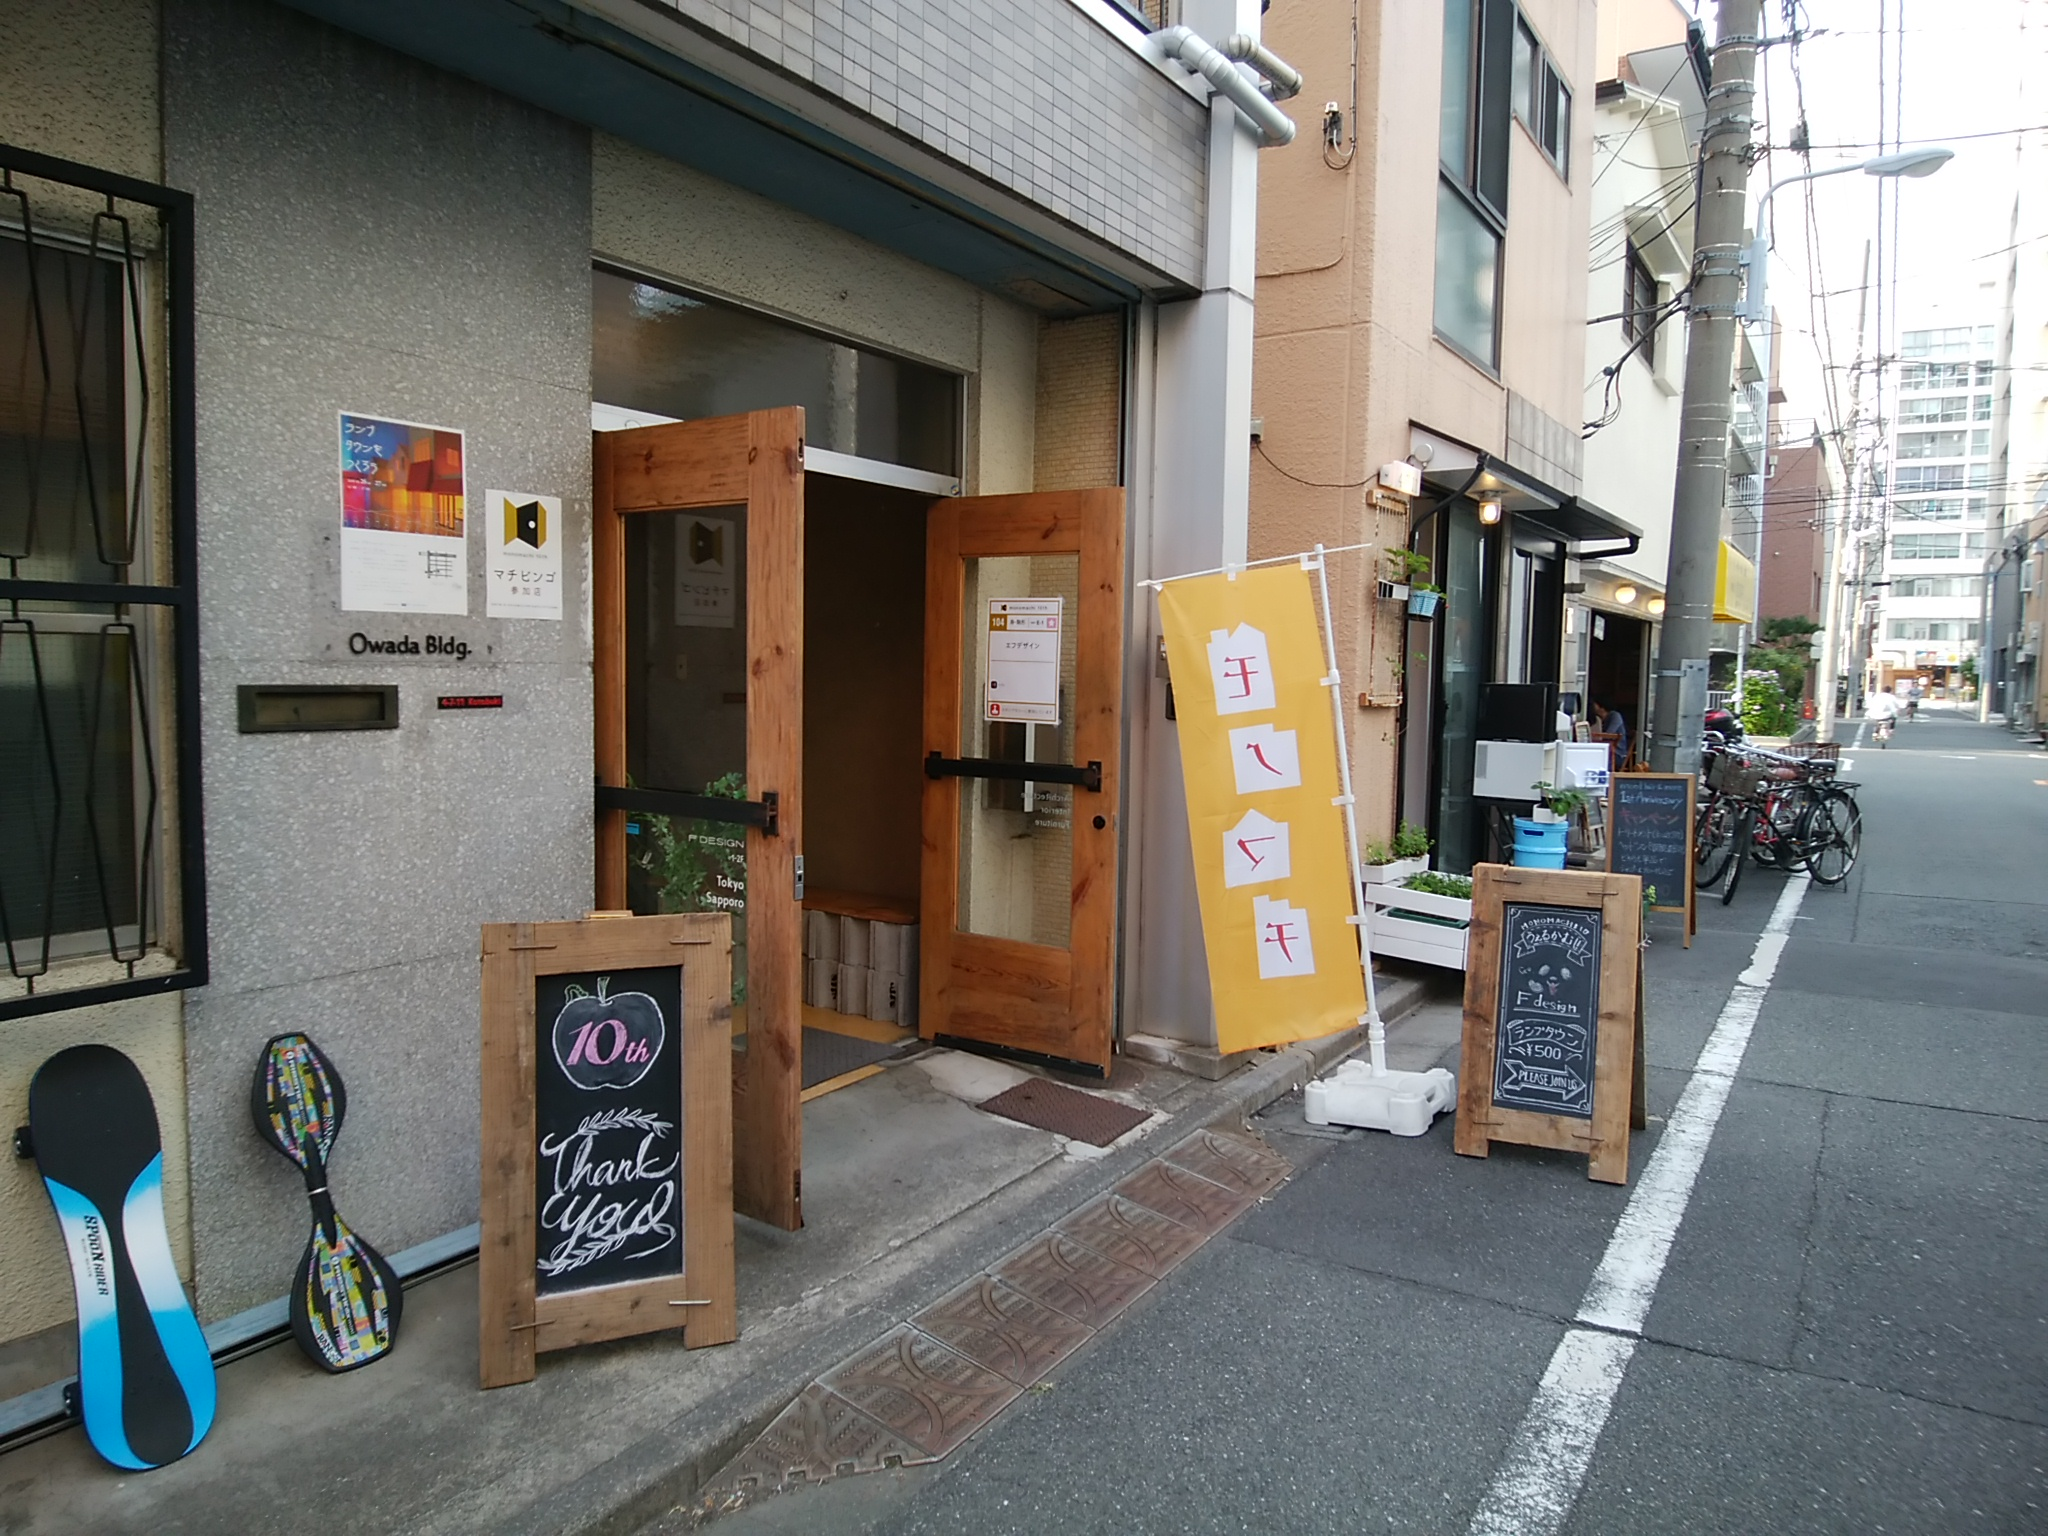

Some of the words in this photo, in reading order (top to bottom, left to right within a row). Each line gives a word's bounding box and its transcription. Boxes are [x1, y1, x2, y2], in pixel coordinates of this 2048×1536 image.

[494, 569, 556, 583] マチビンゴ
[349, 632, 420, 655] Owada
[425, 634, 472, 661] Bldg.
[1005, 642, 1040, 650] エフデザイン
[699, 835, 745, 849] DESIGN
[716, 875, 744, 893] Tokyo
[705, 892, 744, 909] Sapporo
[1517, 991, 1532, 1005] F
[1534, 994, 1577, 1014] design
[566, 1019, 650, 1066] 10th
[1526, 1043, 1562, 1060] ¥500
[1518, 1070, 1549, 1087] PLEASE
[1549, 1075, 1568, 1089] JOIN
[1567, 1078, 1578, 1091] US
[540, 1132, 680, 1196] Thank
[84, 1215, 104, 1261] SPOON
[94, 1262, 109, 1295] RIDER
